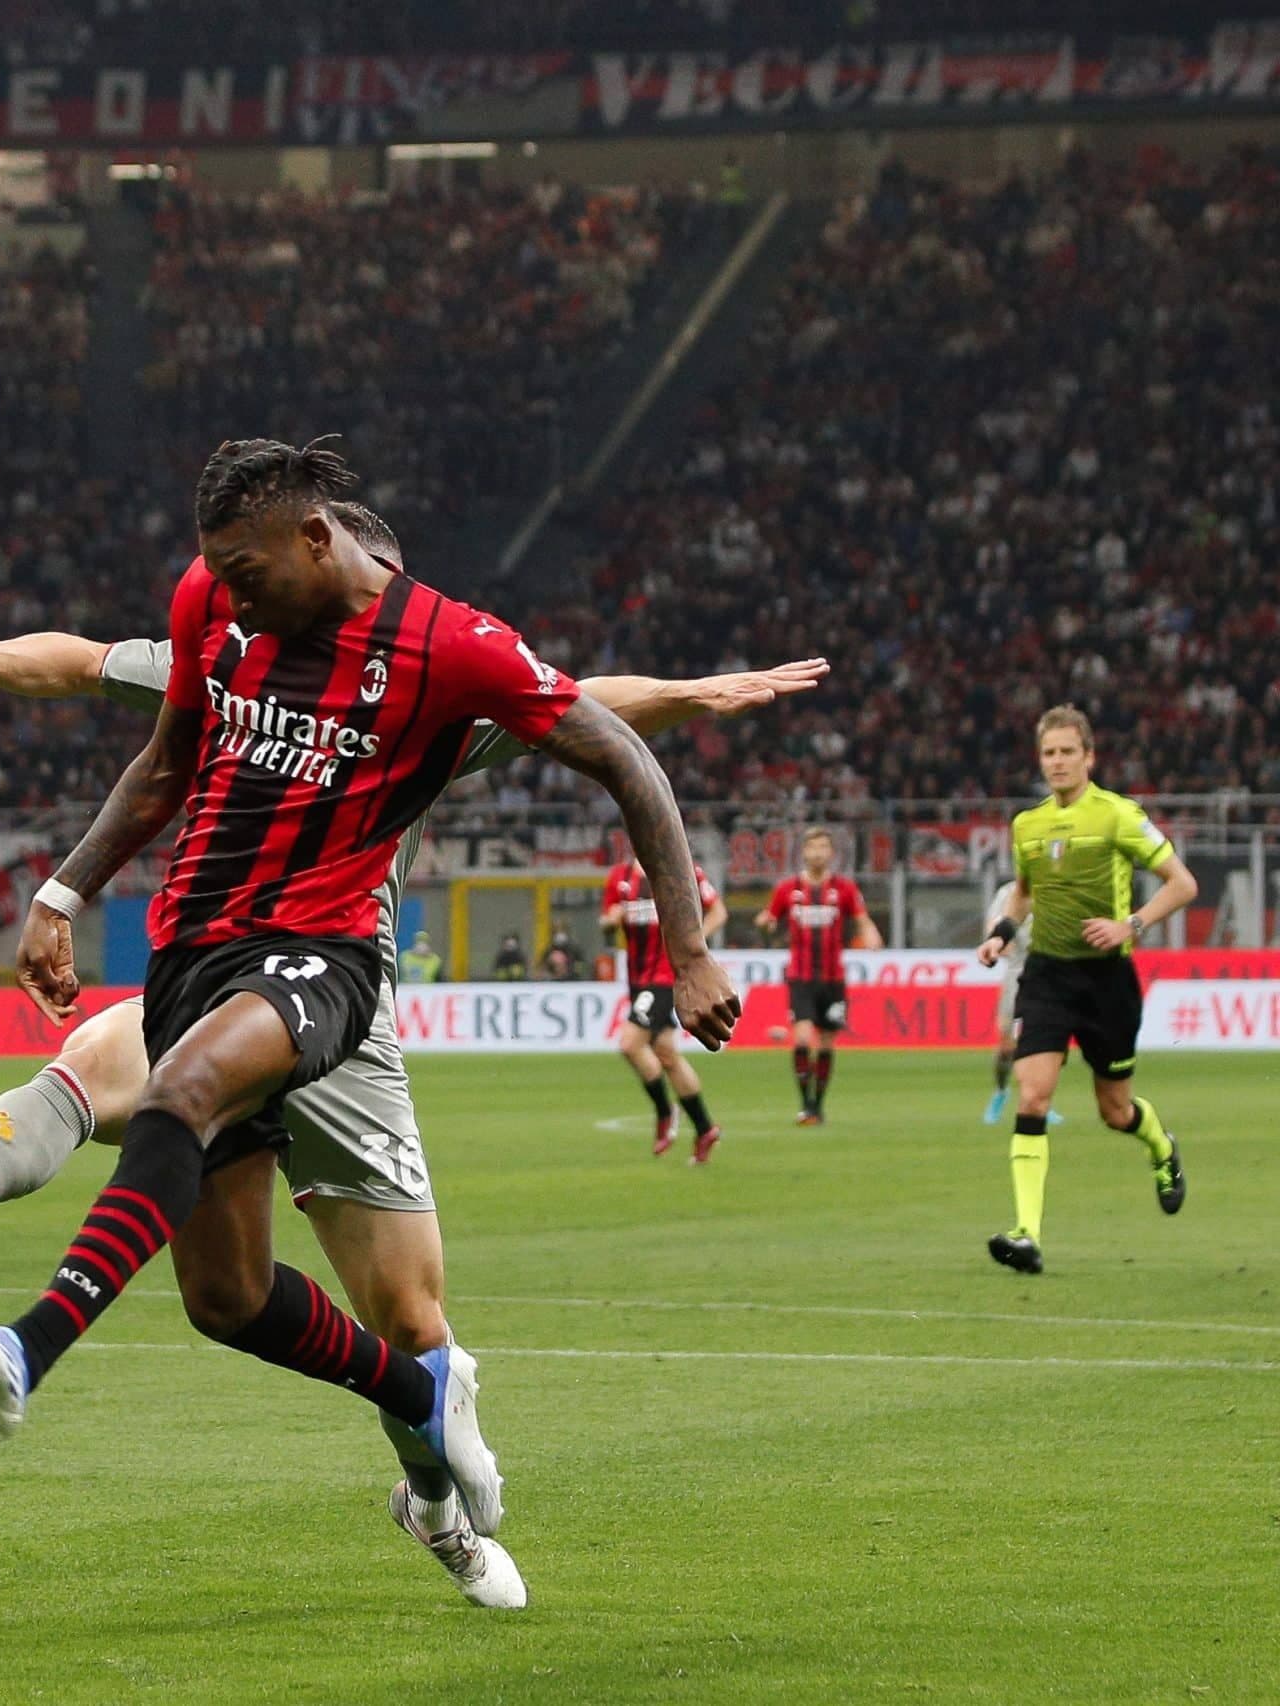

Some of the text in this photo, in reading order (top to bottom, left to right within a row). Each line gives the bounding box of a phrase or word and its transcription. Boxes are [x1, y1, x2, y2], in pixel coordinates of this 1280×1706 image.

[205, 676, 381, 759] Emirates
[217, 722, 340, 788] FLY BETTER
[57, 1267, 101, 1299] ACM
